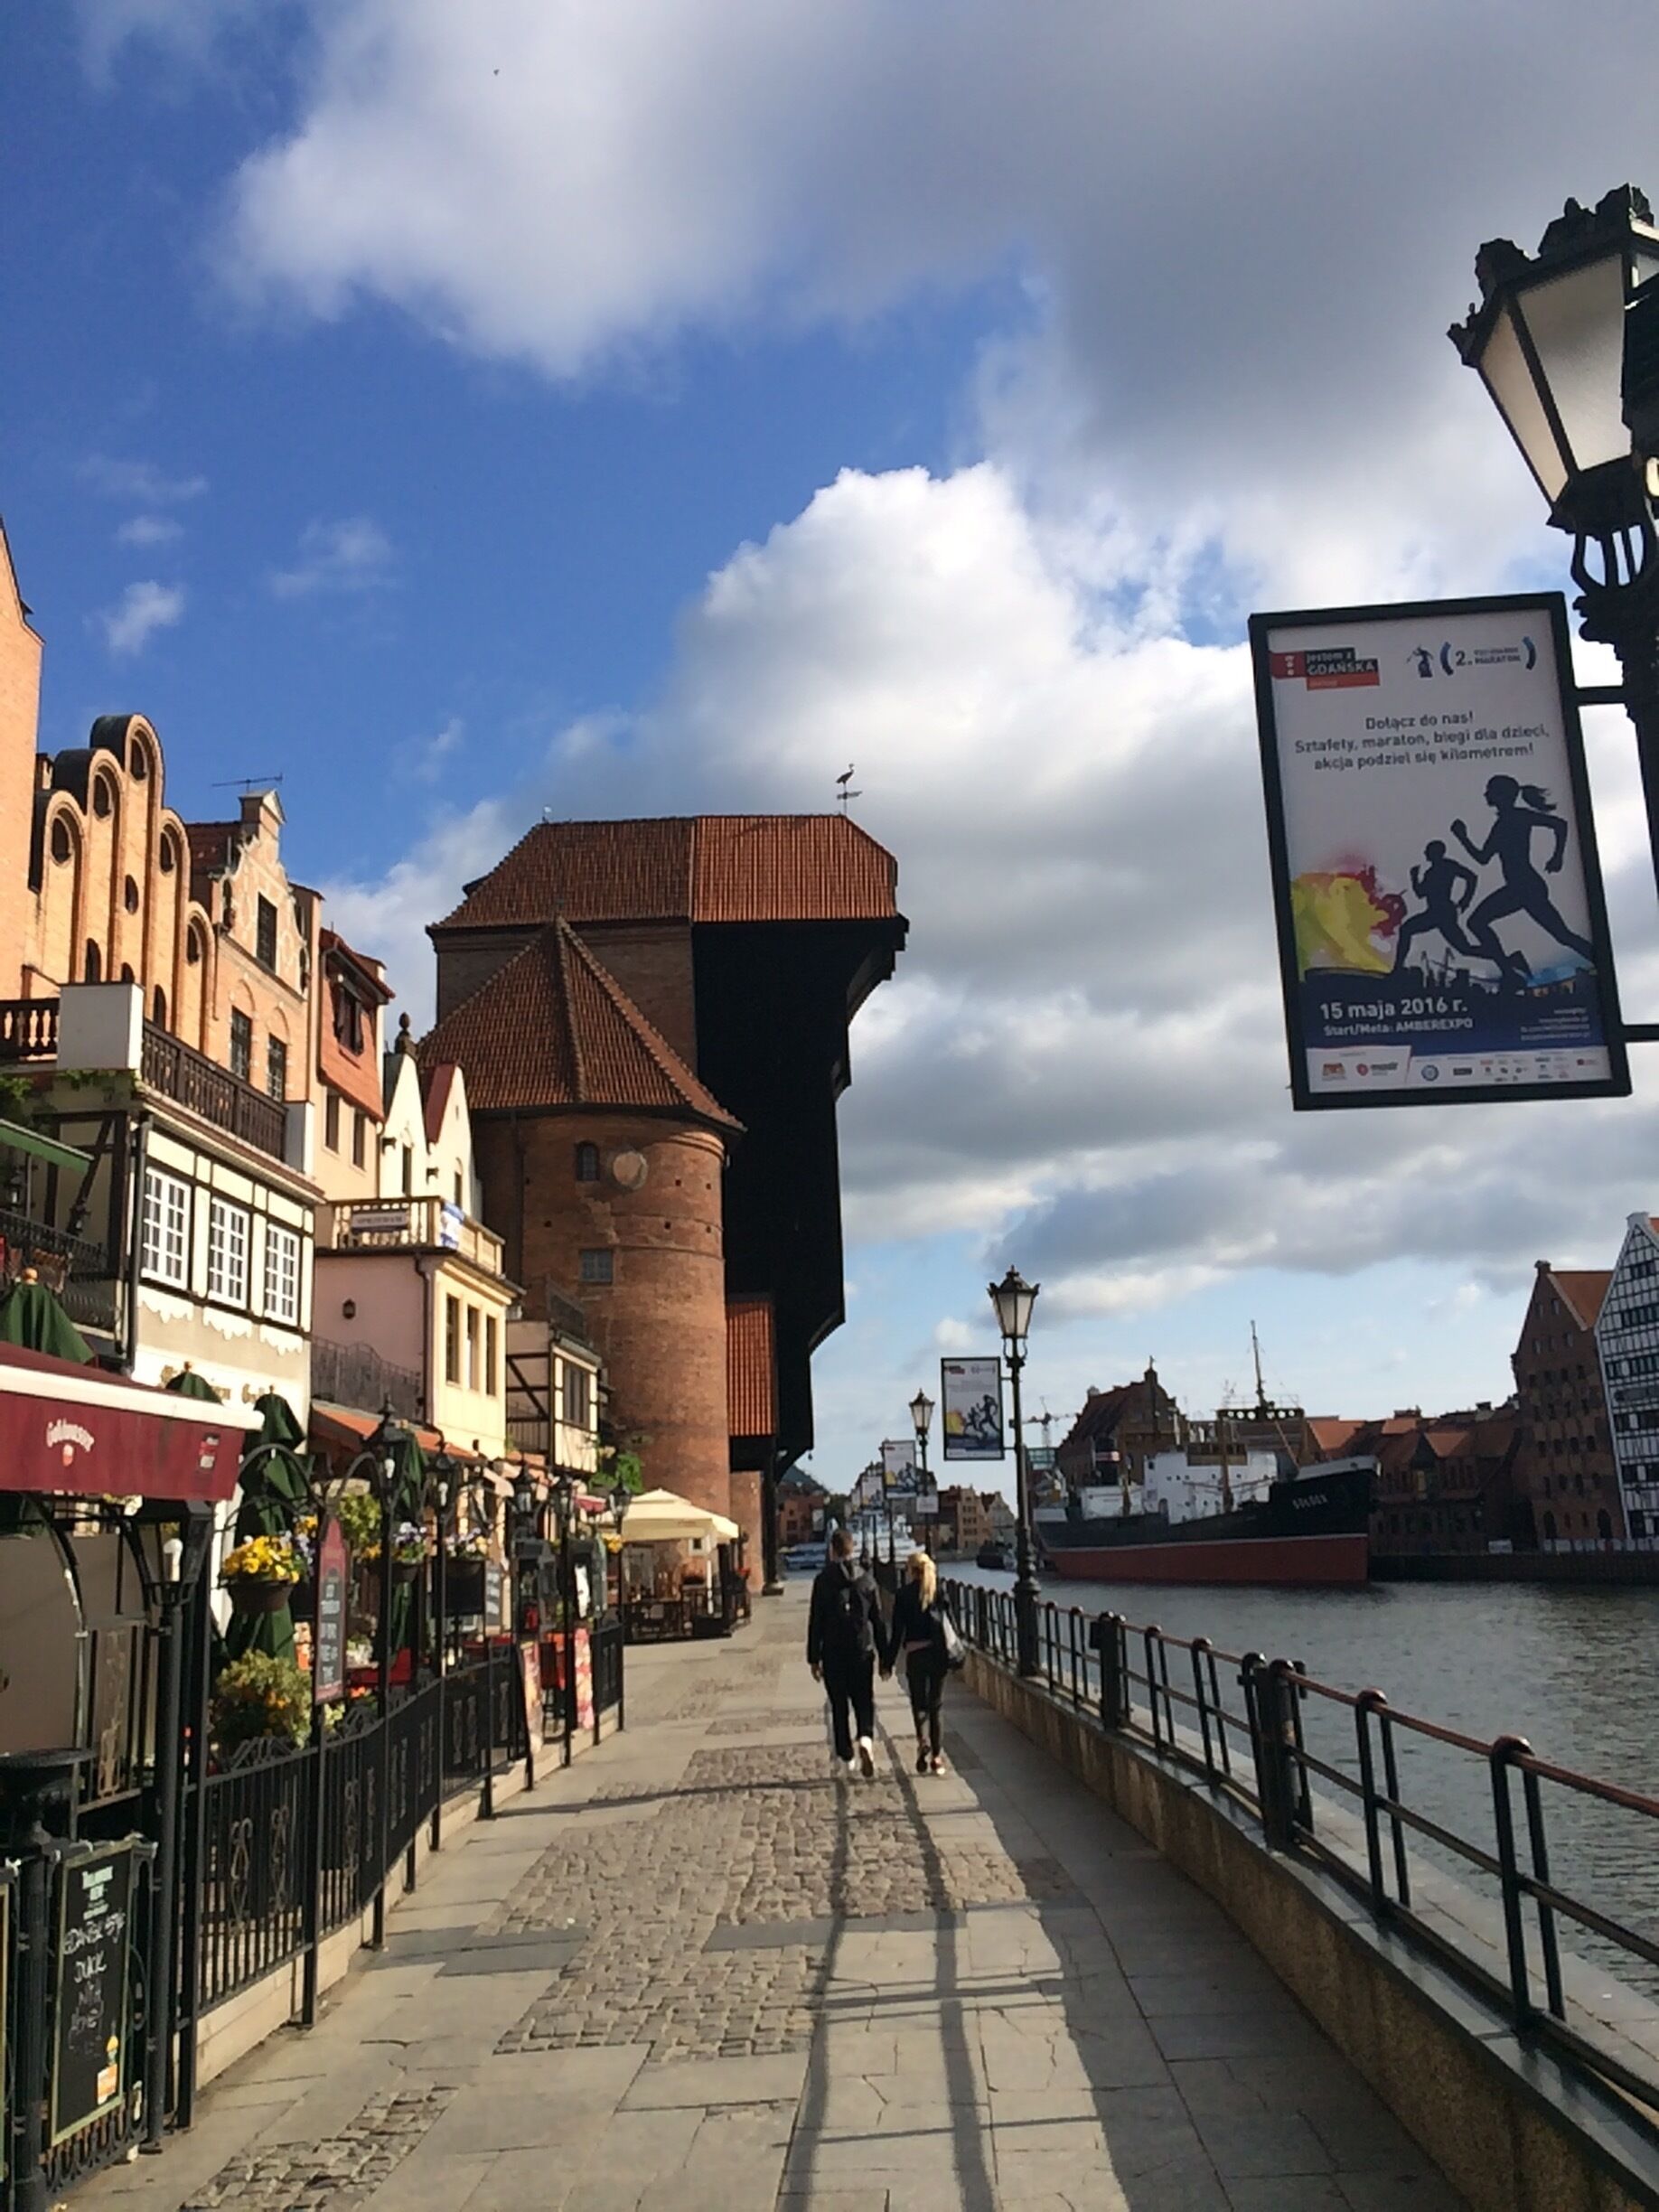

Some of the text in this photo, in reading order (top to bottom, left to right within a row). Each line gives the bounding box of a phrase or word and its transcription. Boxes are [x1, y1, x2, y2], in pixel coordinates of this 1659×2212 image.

[1456, 650, 1473, 666] 2.
[1365, 711, 1474, 733] Dołącz do nas!
[1295, 723, 1551, 755] Sztafety, maraton, biegi dla dzieci,
[1314, 742, 1535, 773] akcja podziel się kilometrem!
[1320, 997, 1468, 1020] 15 maja 2016 r.
[1395, 1017, 1474, 1033] AMBEREXPO
